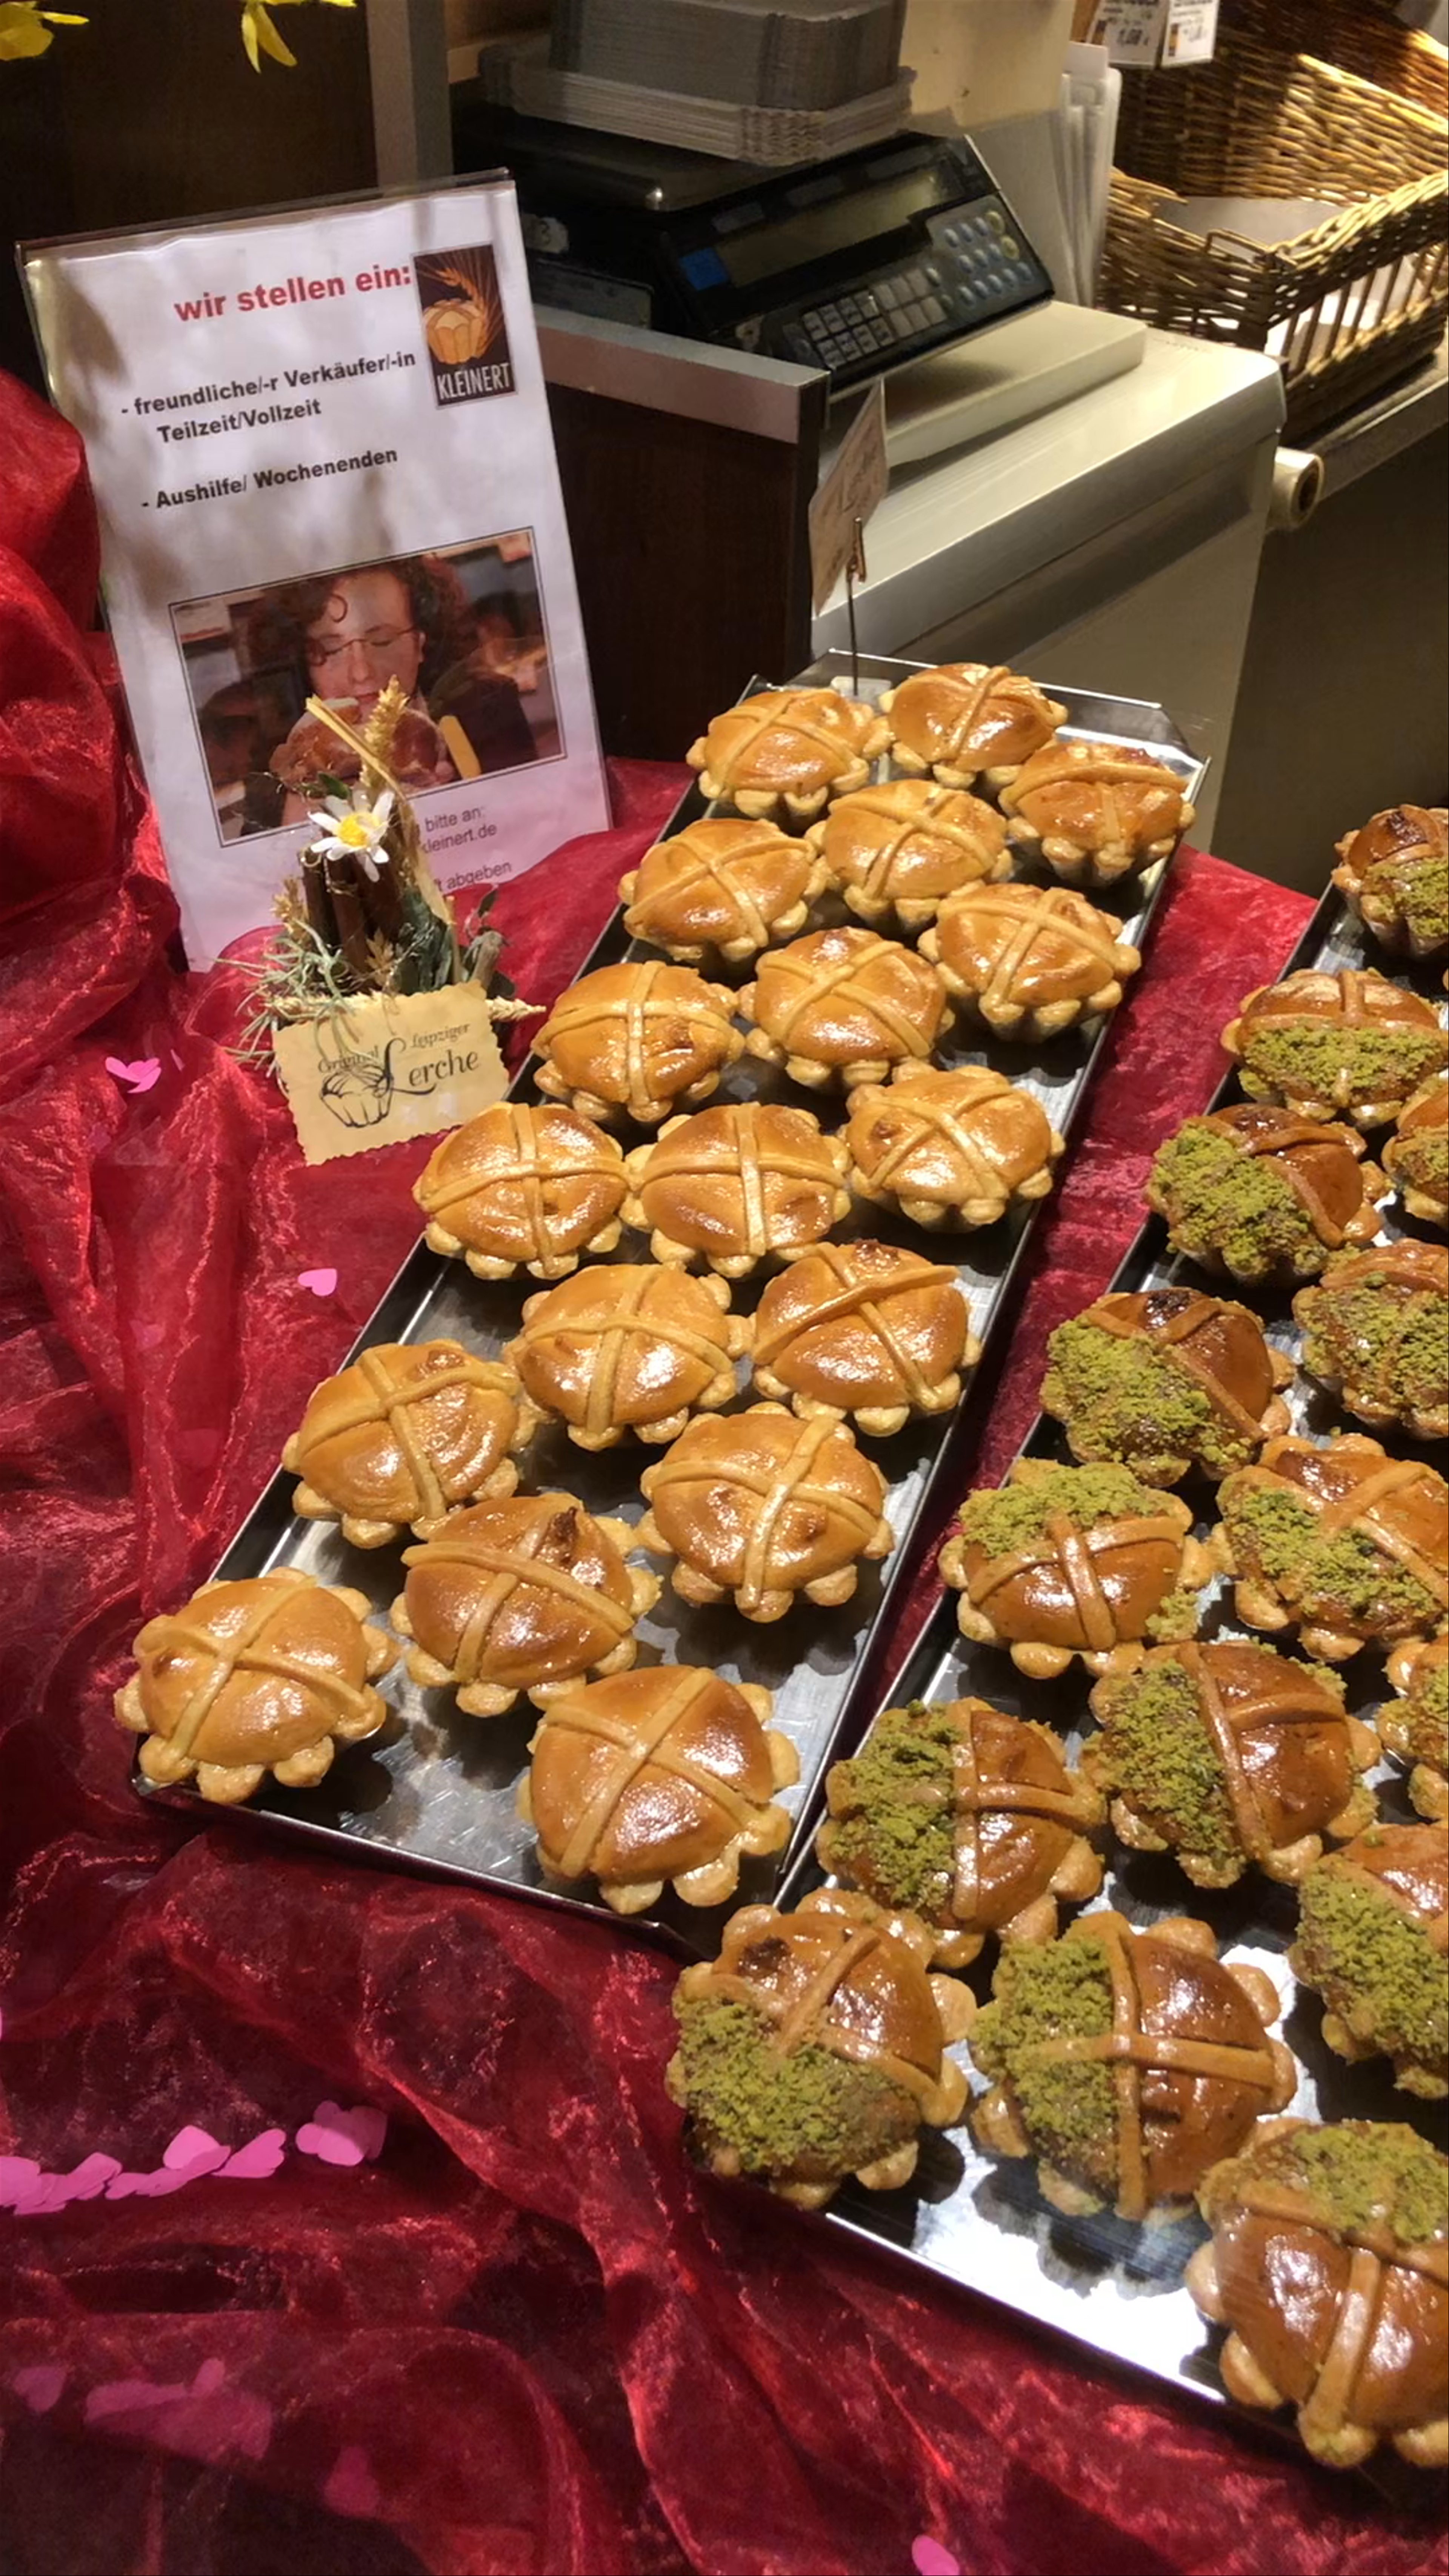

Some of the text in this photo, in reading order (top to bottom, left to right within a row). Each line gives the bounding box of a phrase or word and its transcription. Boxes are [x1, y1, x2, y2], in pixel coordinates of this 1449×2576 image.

[174, 265, 412, 321] wir stellen ein:
[134, 376, 278, 415] freundliche/-r
[284, 351, 416, 388] Verkäufer/-in
[437, 363, 510, 400] KLEINERT
[157, 398, 322, 443] Teilzeit/Vollzeit
[156, 475, 247, 508] Aushilfe/
[254, 448, 398, 488] Wochenenden
[425, 813, 458, 832] bitte
[447, 862, 512, 889] abgeben
